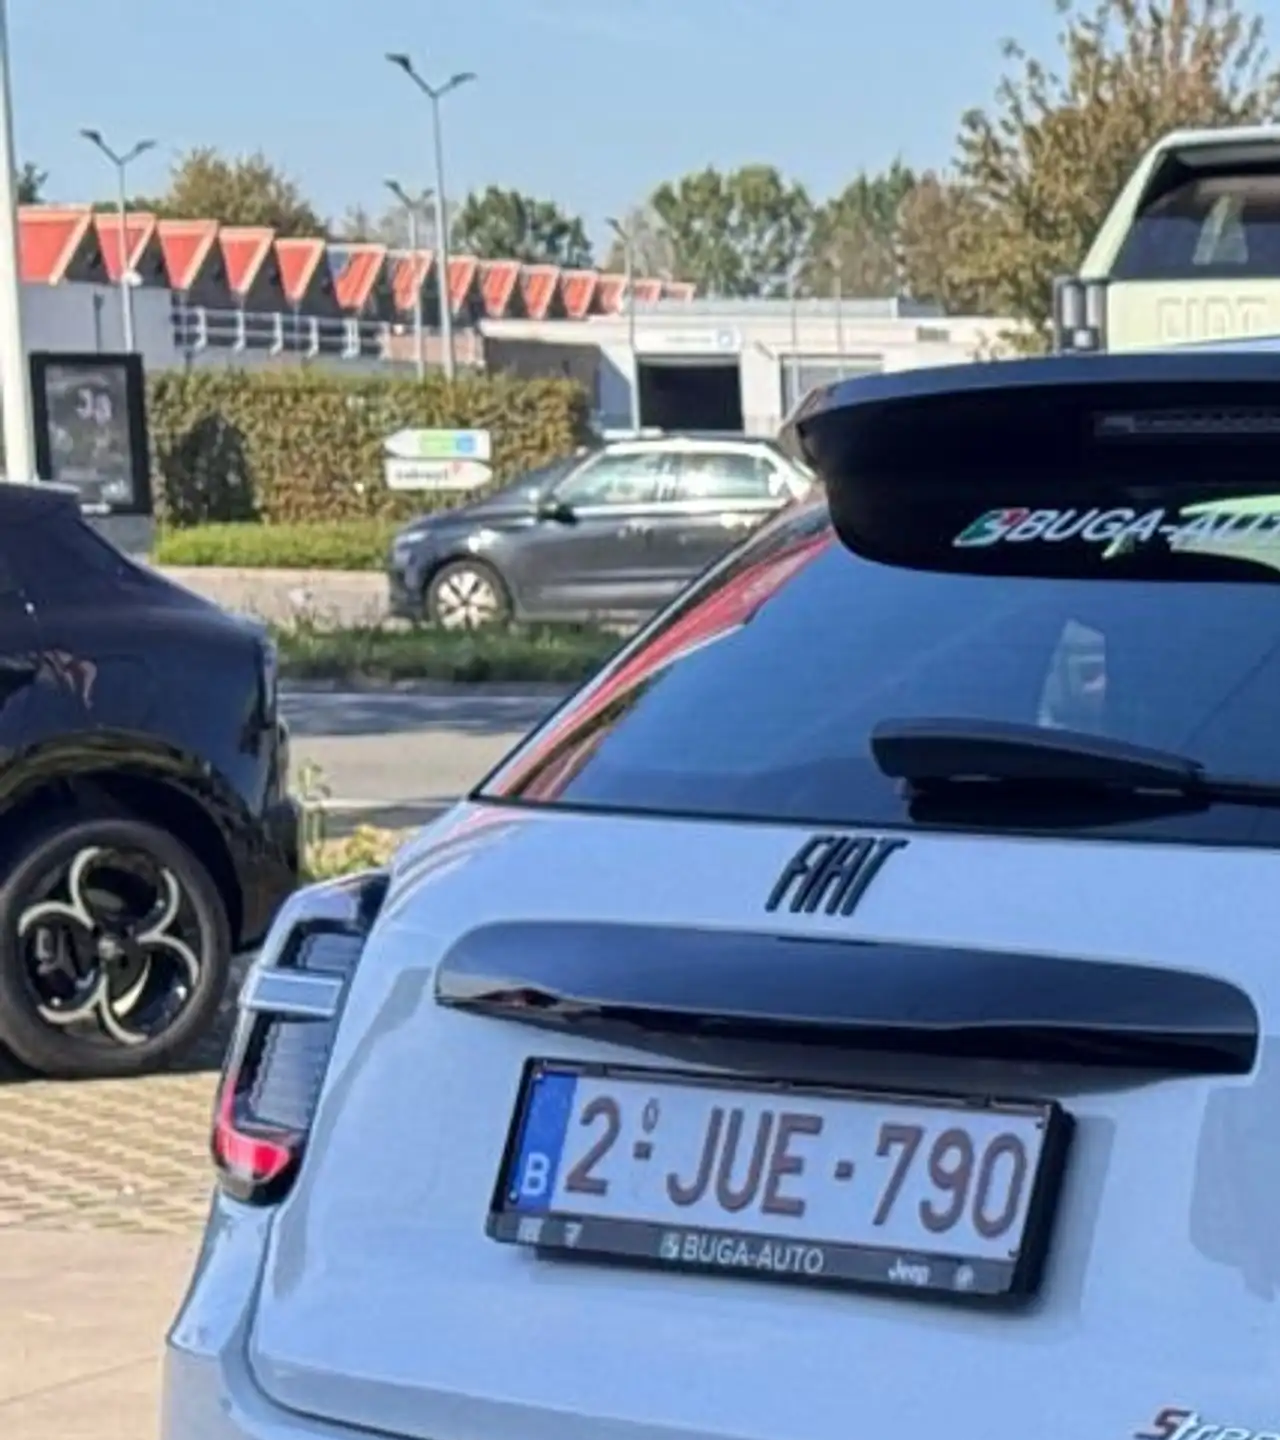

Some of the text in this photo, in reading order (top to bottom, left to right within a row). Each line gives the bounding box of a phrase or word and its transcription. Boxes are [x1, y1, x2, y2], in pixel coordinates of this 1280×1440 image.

[764, 833, 911, 917] FIAT
[521, 1152, 551, 1198] B
[682, 1235, 825, 1274] BUGA-AUTO
